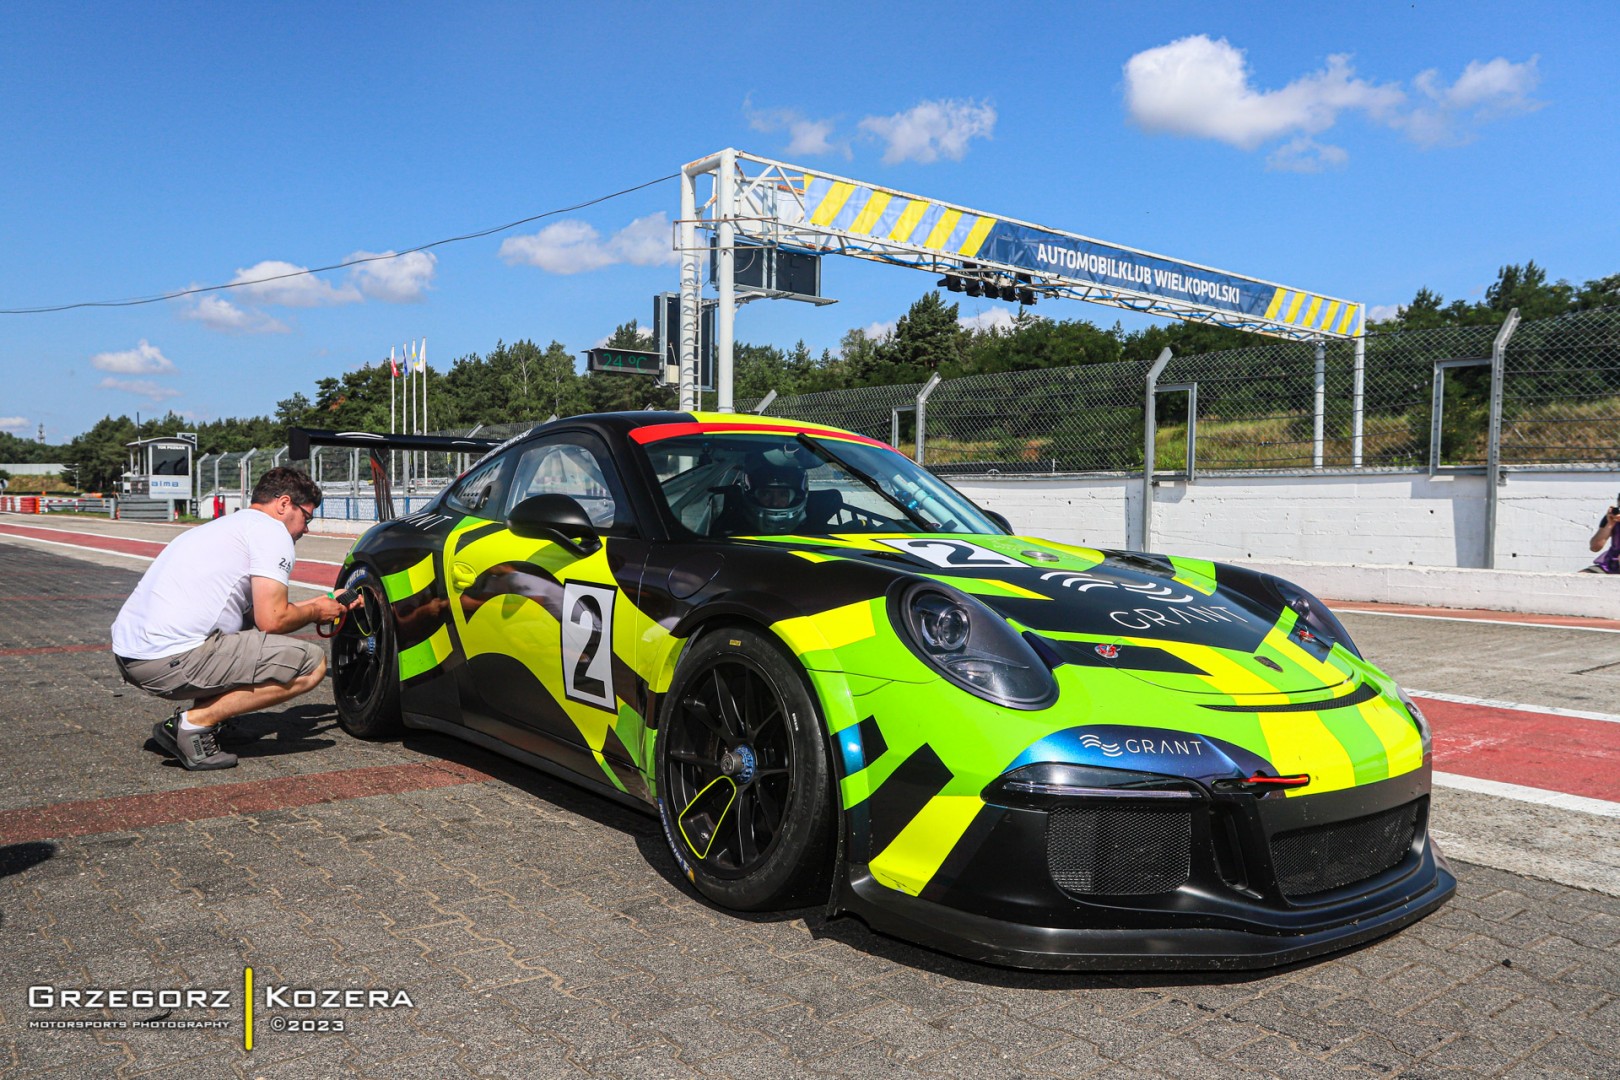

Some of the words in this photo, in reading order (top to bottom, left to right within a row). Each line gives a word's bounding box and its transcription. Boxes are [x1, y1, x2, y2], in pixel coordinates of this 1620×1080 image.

[1036, 243, 1152, 285] AUTOMOBILKLUB
[1154, 269, 1240, 304] WIELKOPOLSKI
[602, 352, 623, 372] 24
[907, 540, 1012, 565] 2
[1109, 605, 1249, 630] GRANT
[570, 594, 606, 699] 2
[1125, 739, 1202, 756] GRANT
